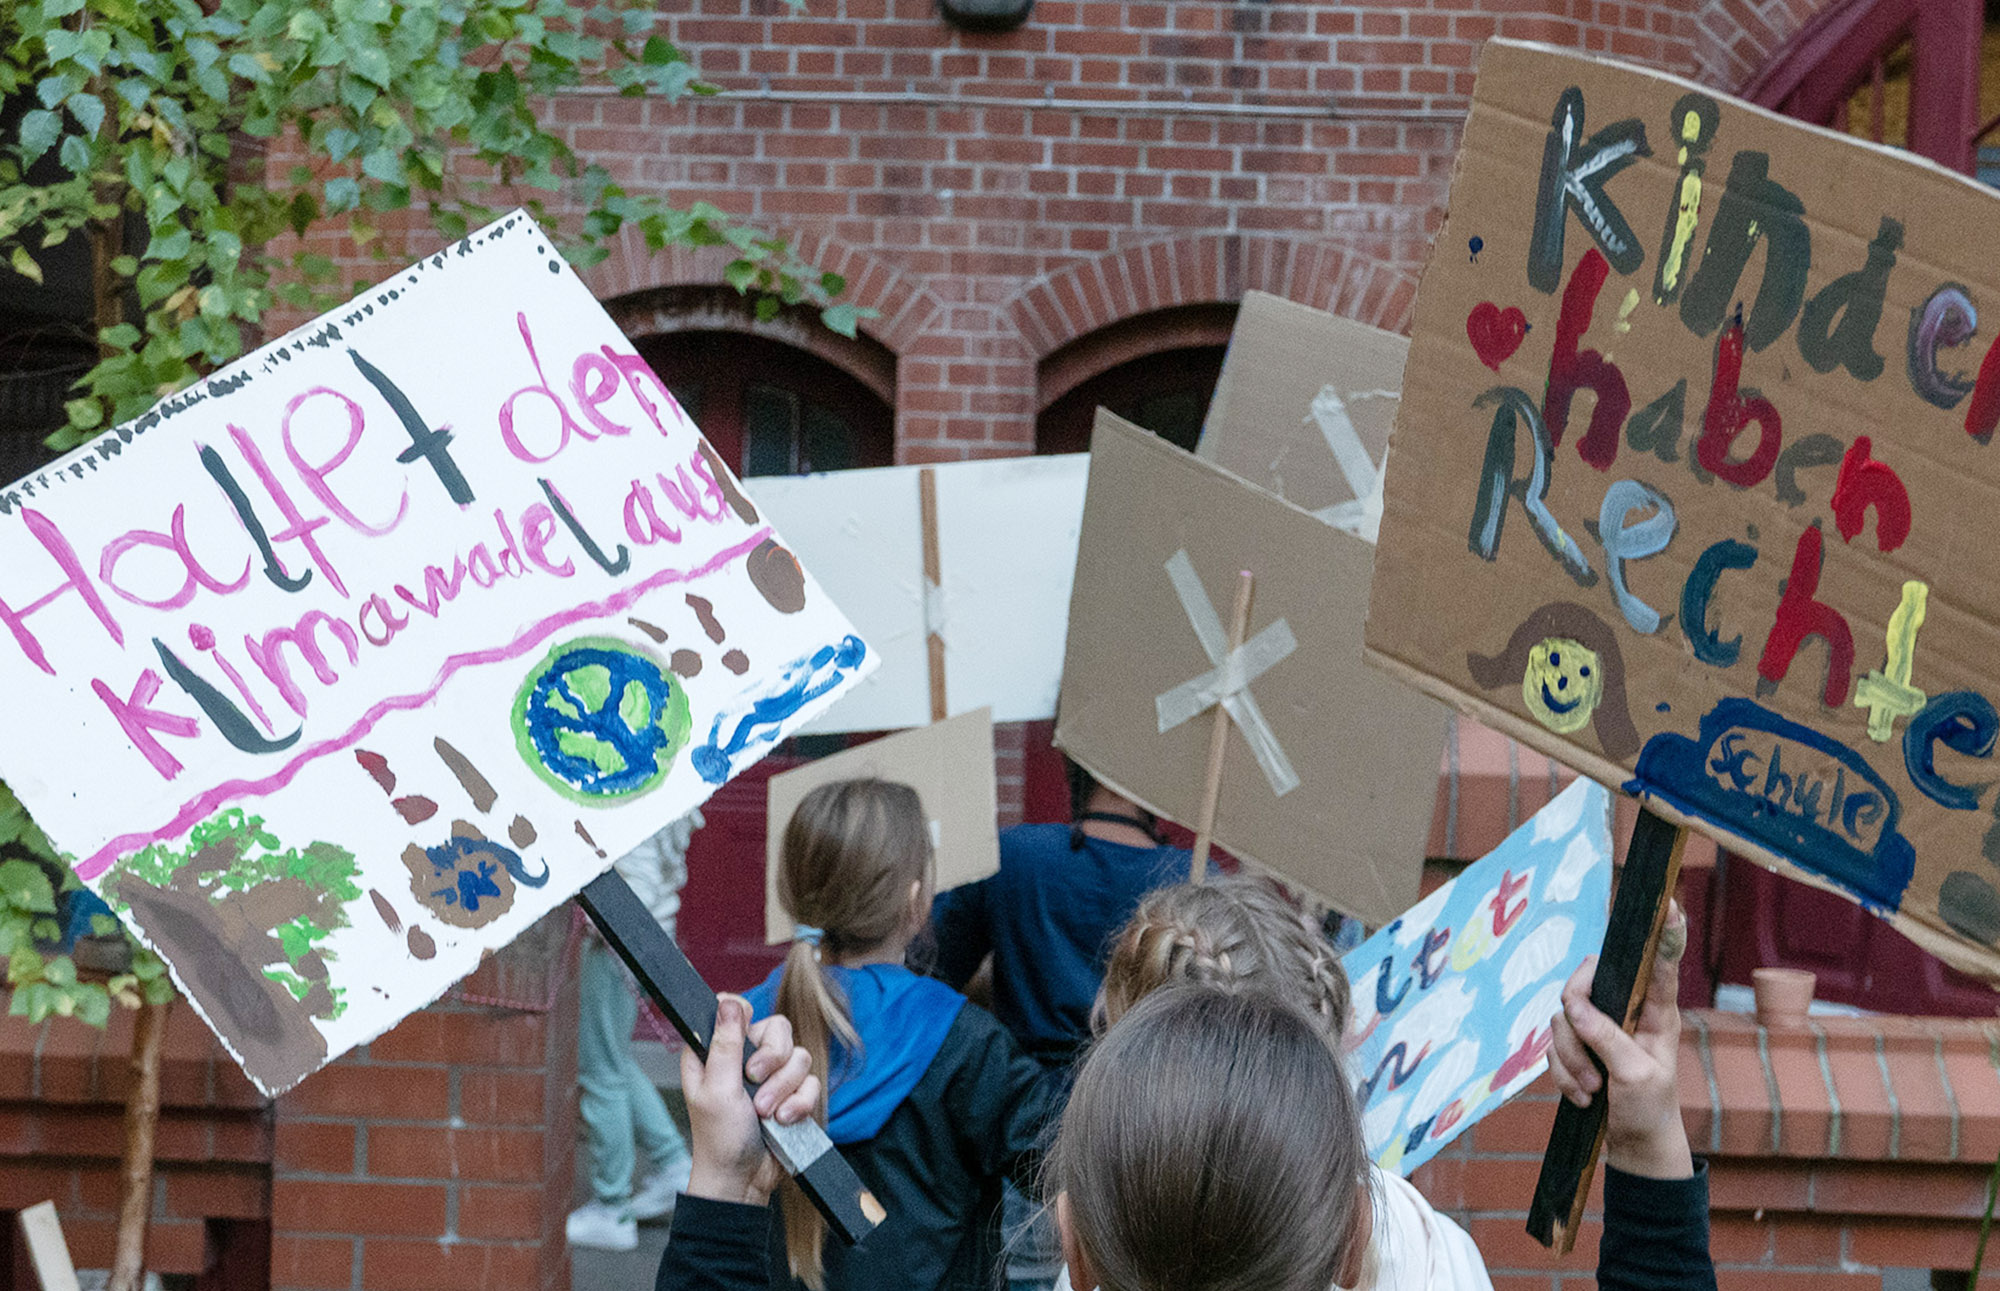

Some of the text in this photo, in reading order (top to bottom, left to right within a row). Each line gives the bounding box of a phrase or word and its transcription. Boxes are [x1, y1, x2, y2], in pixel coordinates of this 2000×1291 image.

[0, 311, 685, 676] Haltet den
[1467, 385, 2000, 810] Rechte
